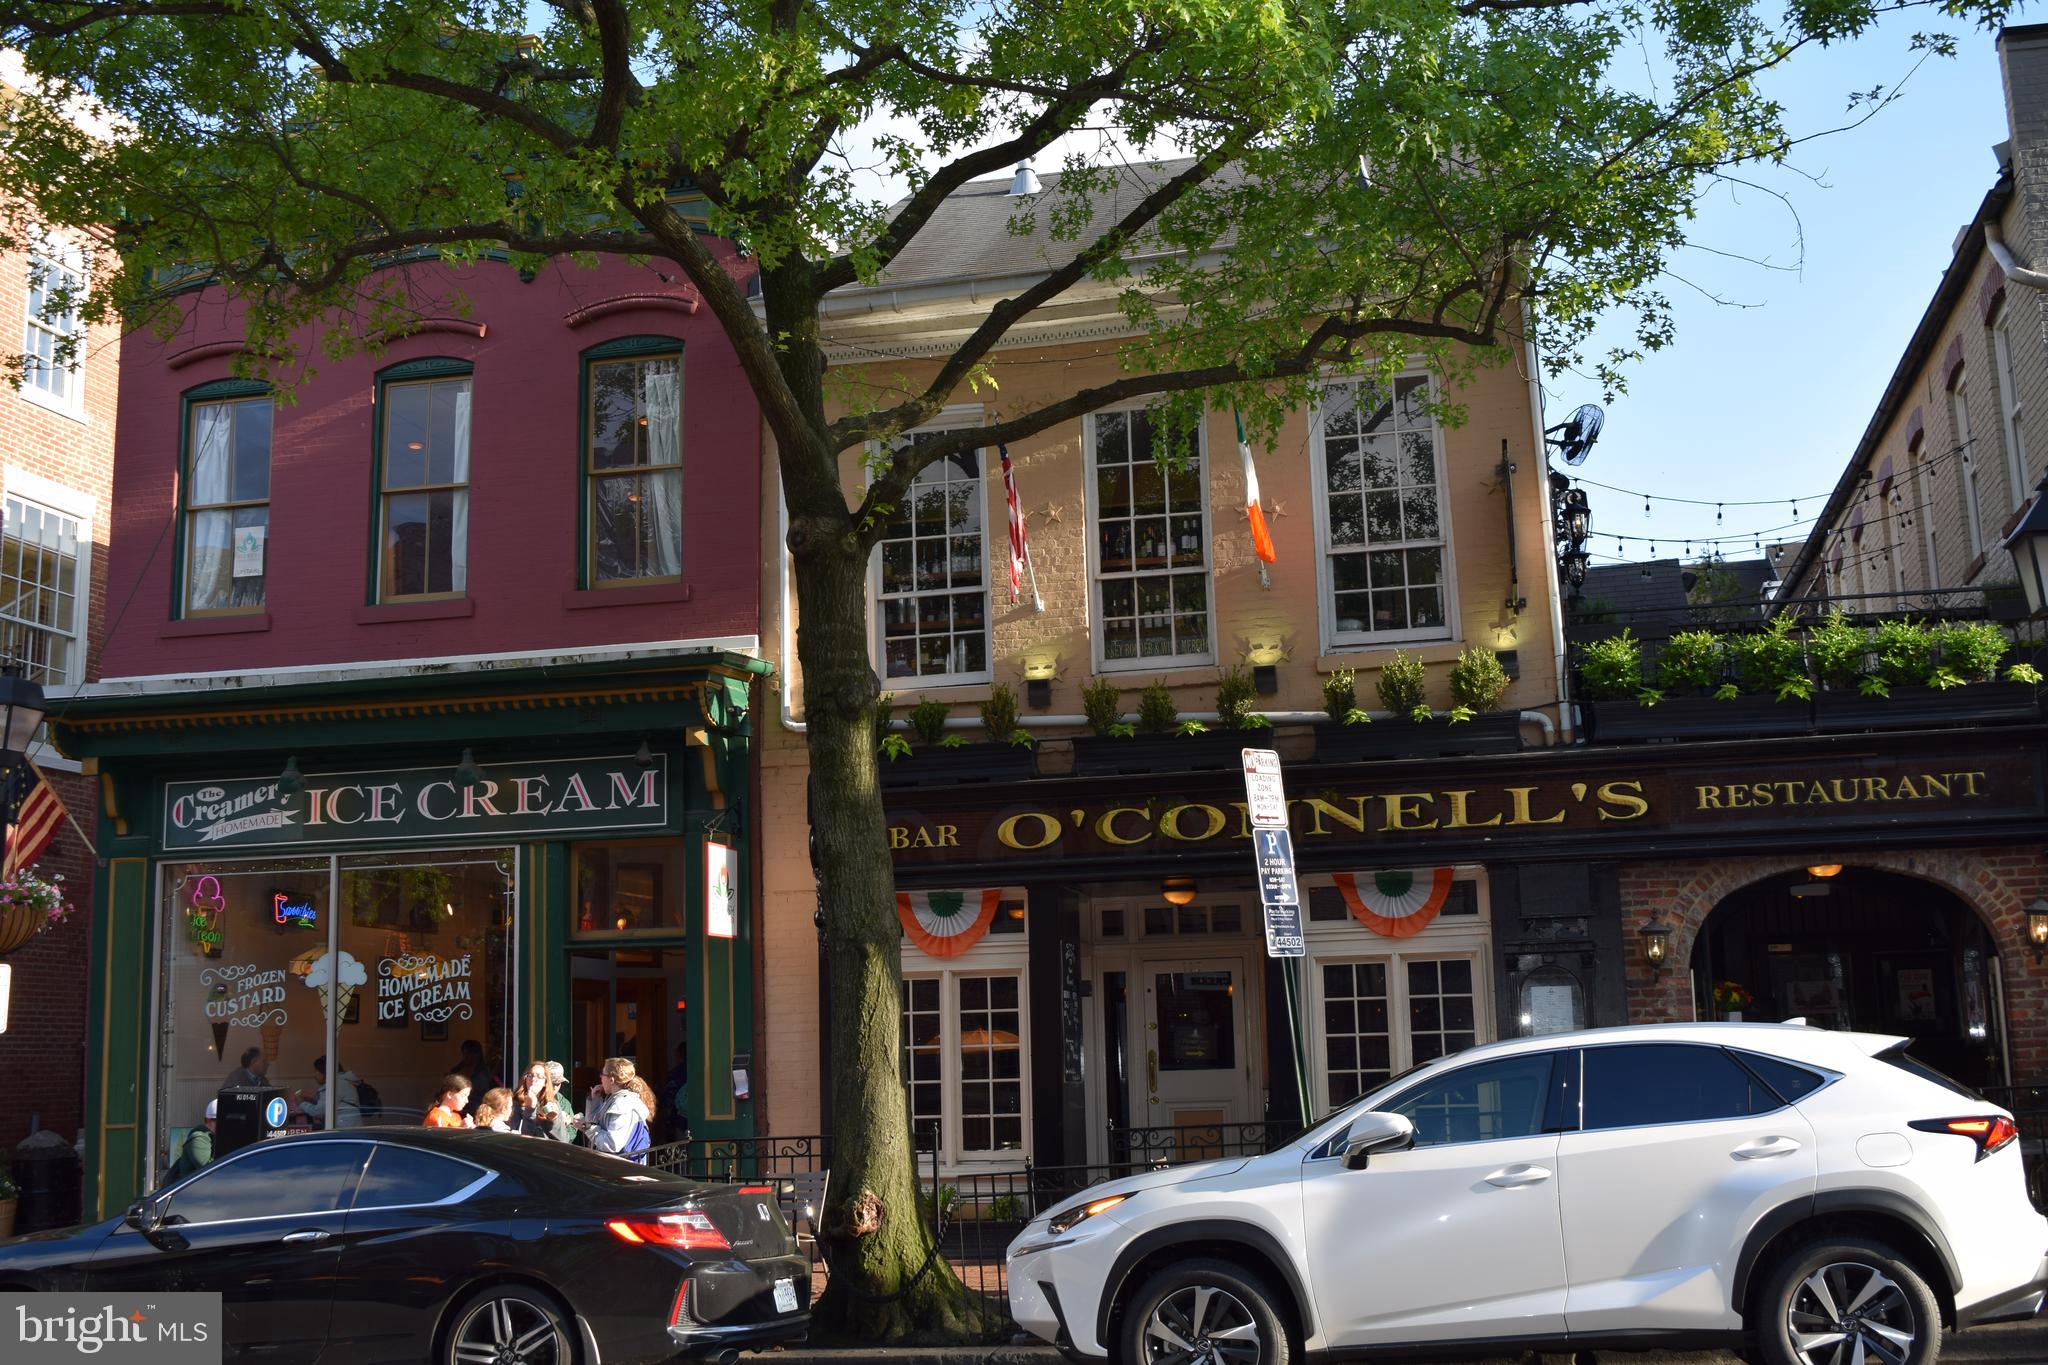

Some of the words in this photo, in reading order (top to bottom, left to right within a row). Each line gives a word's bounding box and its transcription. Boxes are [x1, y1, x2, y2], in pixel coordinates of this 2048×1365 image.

[1251, 774, 1276, 783] LOADING
[1257, 784, 1272, 792] ZONE
[201, 790, 221, 799] The
[304, 782, 406, 825] ICE
[416, 769, 661, 821] CREAM
[1695, 771, 1985, 810] RESTAURANT
[215, 815, 280, 836] HOMEMADE
[888, 825, 961, 849] BAR
[1260, 867, 1270, 875] PAY
[1271, 867, 1292, 875] PARKING
[1264, 858, 1269, 866] 2
[1277, 938, 1301, 947] 44502
[237, 969, 287, 992] FROZEN
[378, 958, 472, 997] HOMEMADE
[205, 986, 286, 1017] CUSTARD
[378, 998, 406, 1020] ICE
[409, 981, 472, 1011] CREAM
